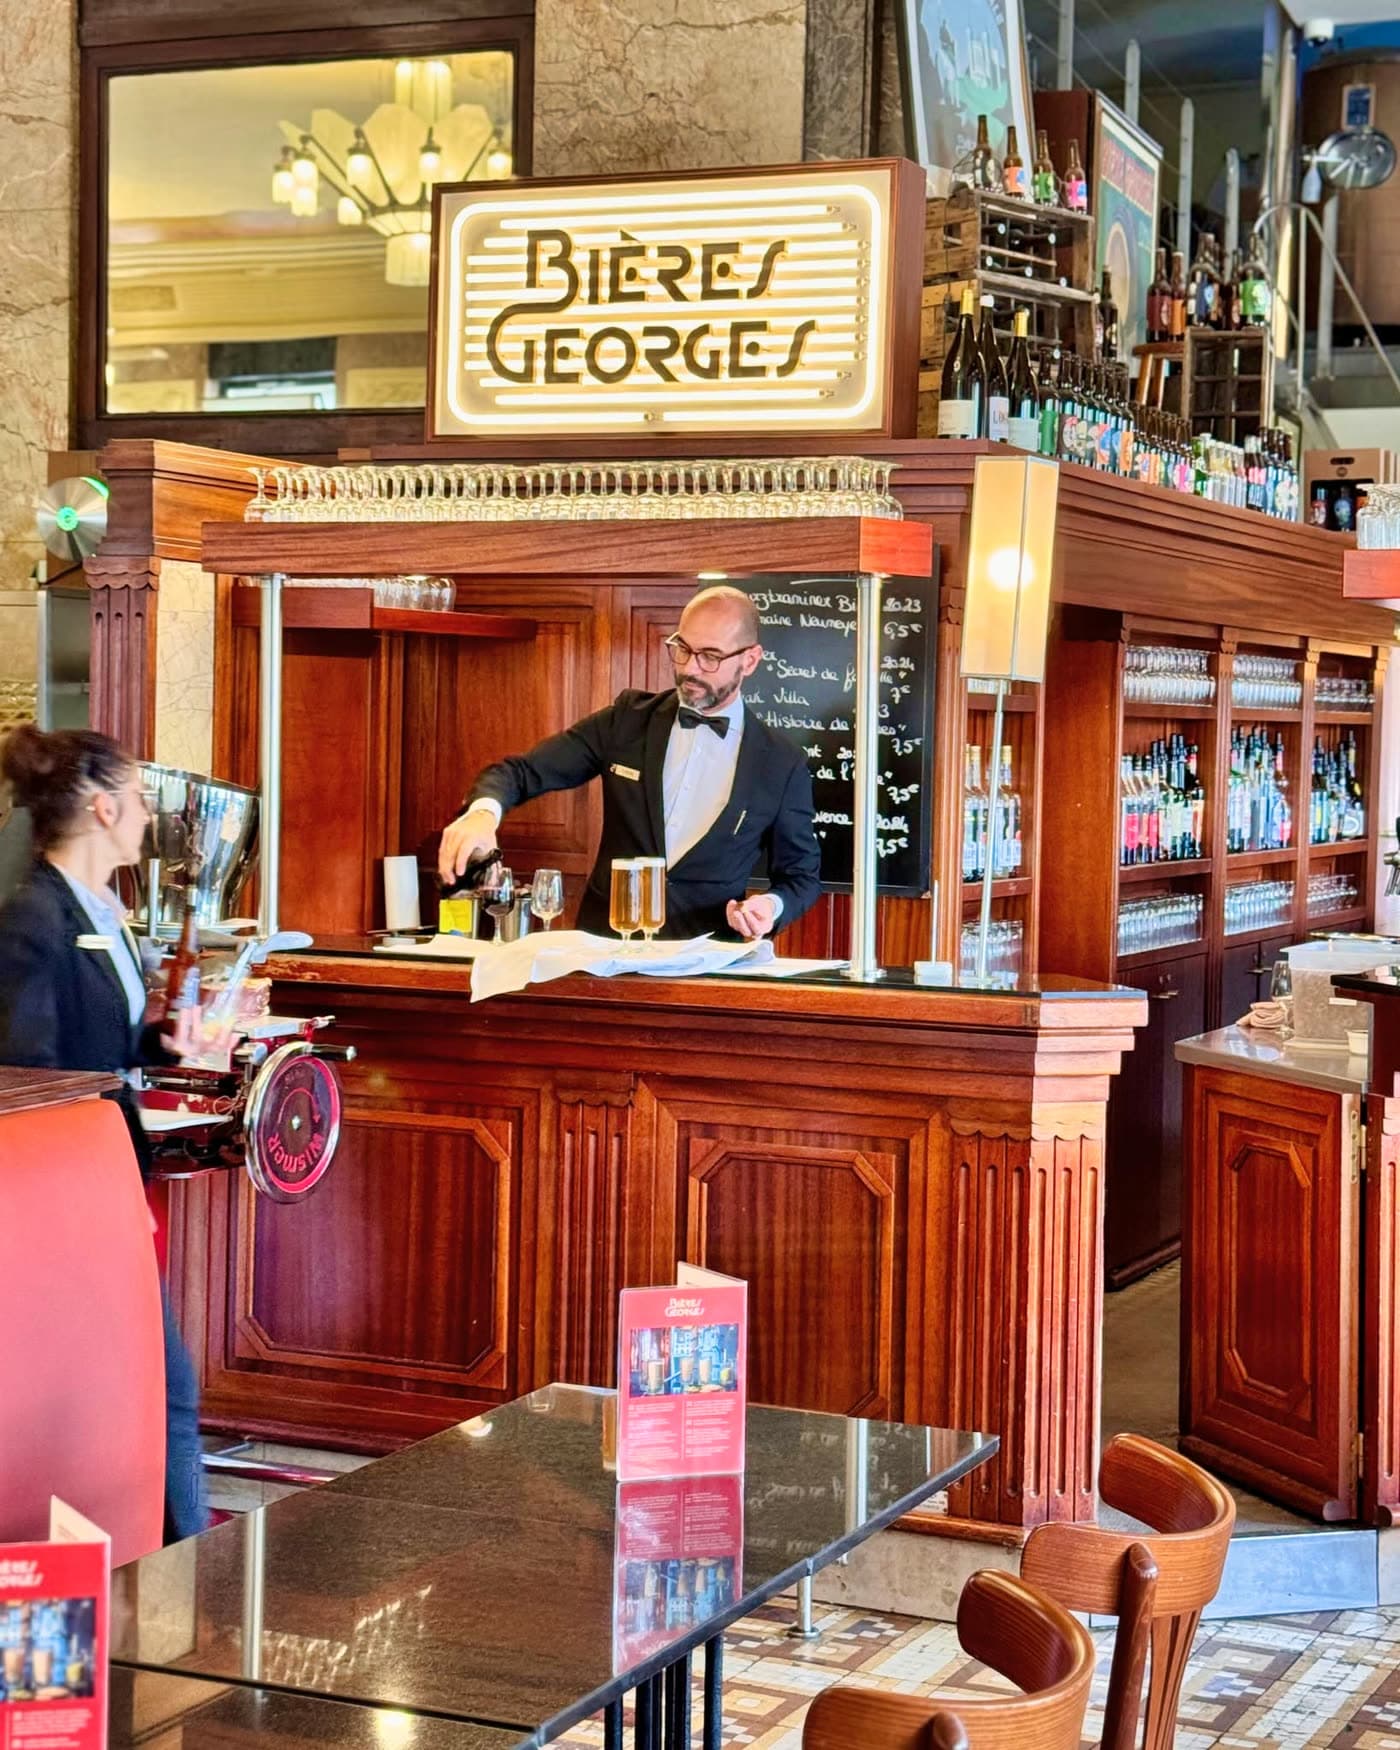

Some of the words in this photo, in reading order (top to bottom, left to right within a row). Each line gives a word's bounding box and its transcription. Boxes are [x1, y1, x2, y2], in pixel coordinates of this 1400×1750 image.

[525, 227, 789, 305] BIÈRES
[486, 301, 815, 384] GEORGES
[835, 594, 856, 613] Bi
[883, 597, 922, 613] 2023
[821, 668, 839, 681] de
[773, 687, 810, 706] Villa
[829, 717, 850, 731] de
[816, 765, 836, 780] de
